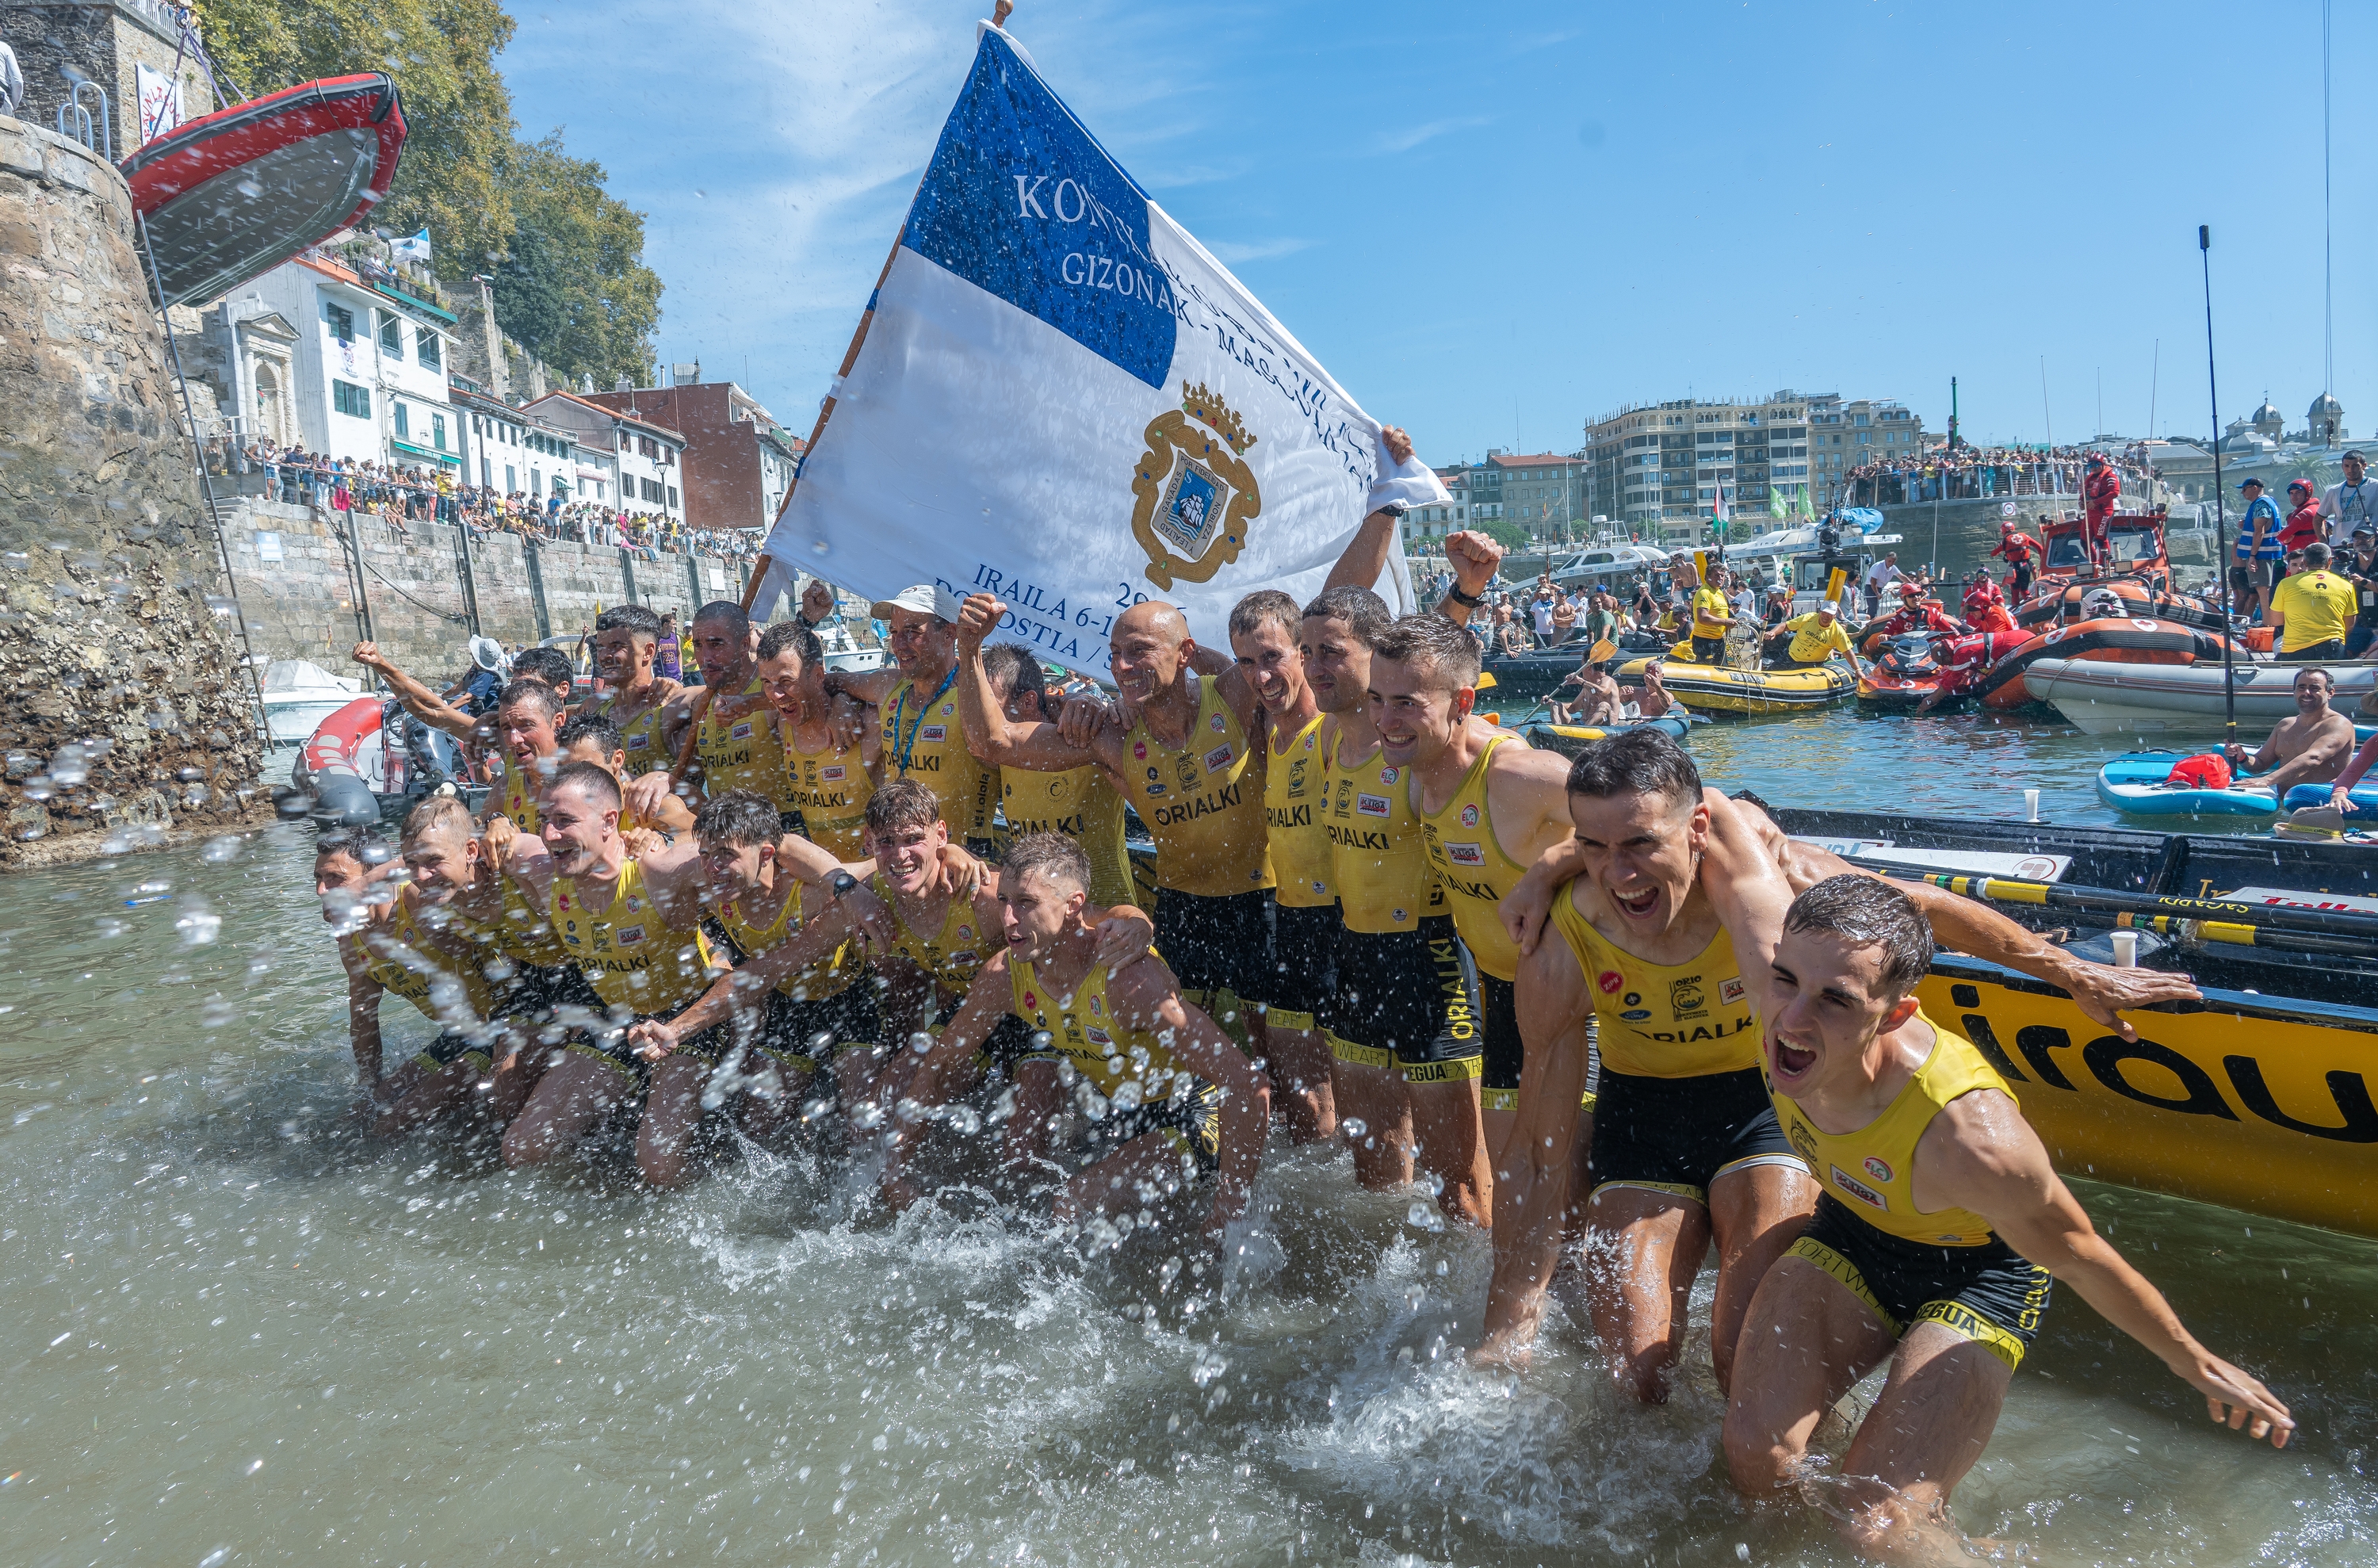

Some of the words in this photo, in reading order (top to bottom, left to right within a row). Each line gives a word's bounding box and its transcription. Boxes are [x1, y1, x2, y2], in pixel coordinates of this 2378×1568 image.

[1062, 252, 1194, 328] GIZONAK
[1180, 455, 1193, 469] POR
[1195, 465, 1224, 491] FIDELIDAD
[1201, 501, 1221, 540] NOBLEZA
[2097, 515, 2110, 536] RESCATE
[1160, 522, 1189, 547] LEALTAD
[973, 564, 1066, 621] IRAILA
[1075, 607, 1112, 637] 6-1
[935, 577, 1079, 659] DOSTIA
[1805, 629, 1827, 644] ORIALKI
[663, 652, 675, 664] 23
[701, 749, 750, 768] ORIALKI
[1179, 752, 1194, 763] ORIO
[1294, 758, 1307, 767] ORIO
[1381, 771, 1394, 780] ELC
[793, 792, 846, 808] ORIALKI
[1155, 783, 1241, 826] ORIALKI
[1368, 800, 1386, 809] LIGA
[1266, 804, 1312, 828] RIALKI
[1462, 813, 1474, 821] ELC
[1324, 824, 1390, 850] RIALKI
[1432, 866, 1500, 901] RIALKI
[1428, 939, 1474, 1041] ORIALKI
[1603, 977, 1619, 991] ZIPR
[1676, 975, 1702, 986] ORIO
[1629, 1015, 1753, 1044] RIALK
[1864, 1161, 1884, 1177] ELC
